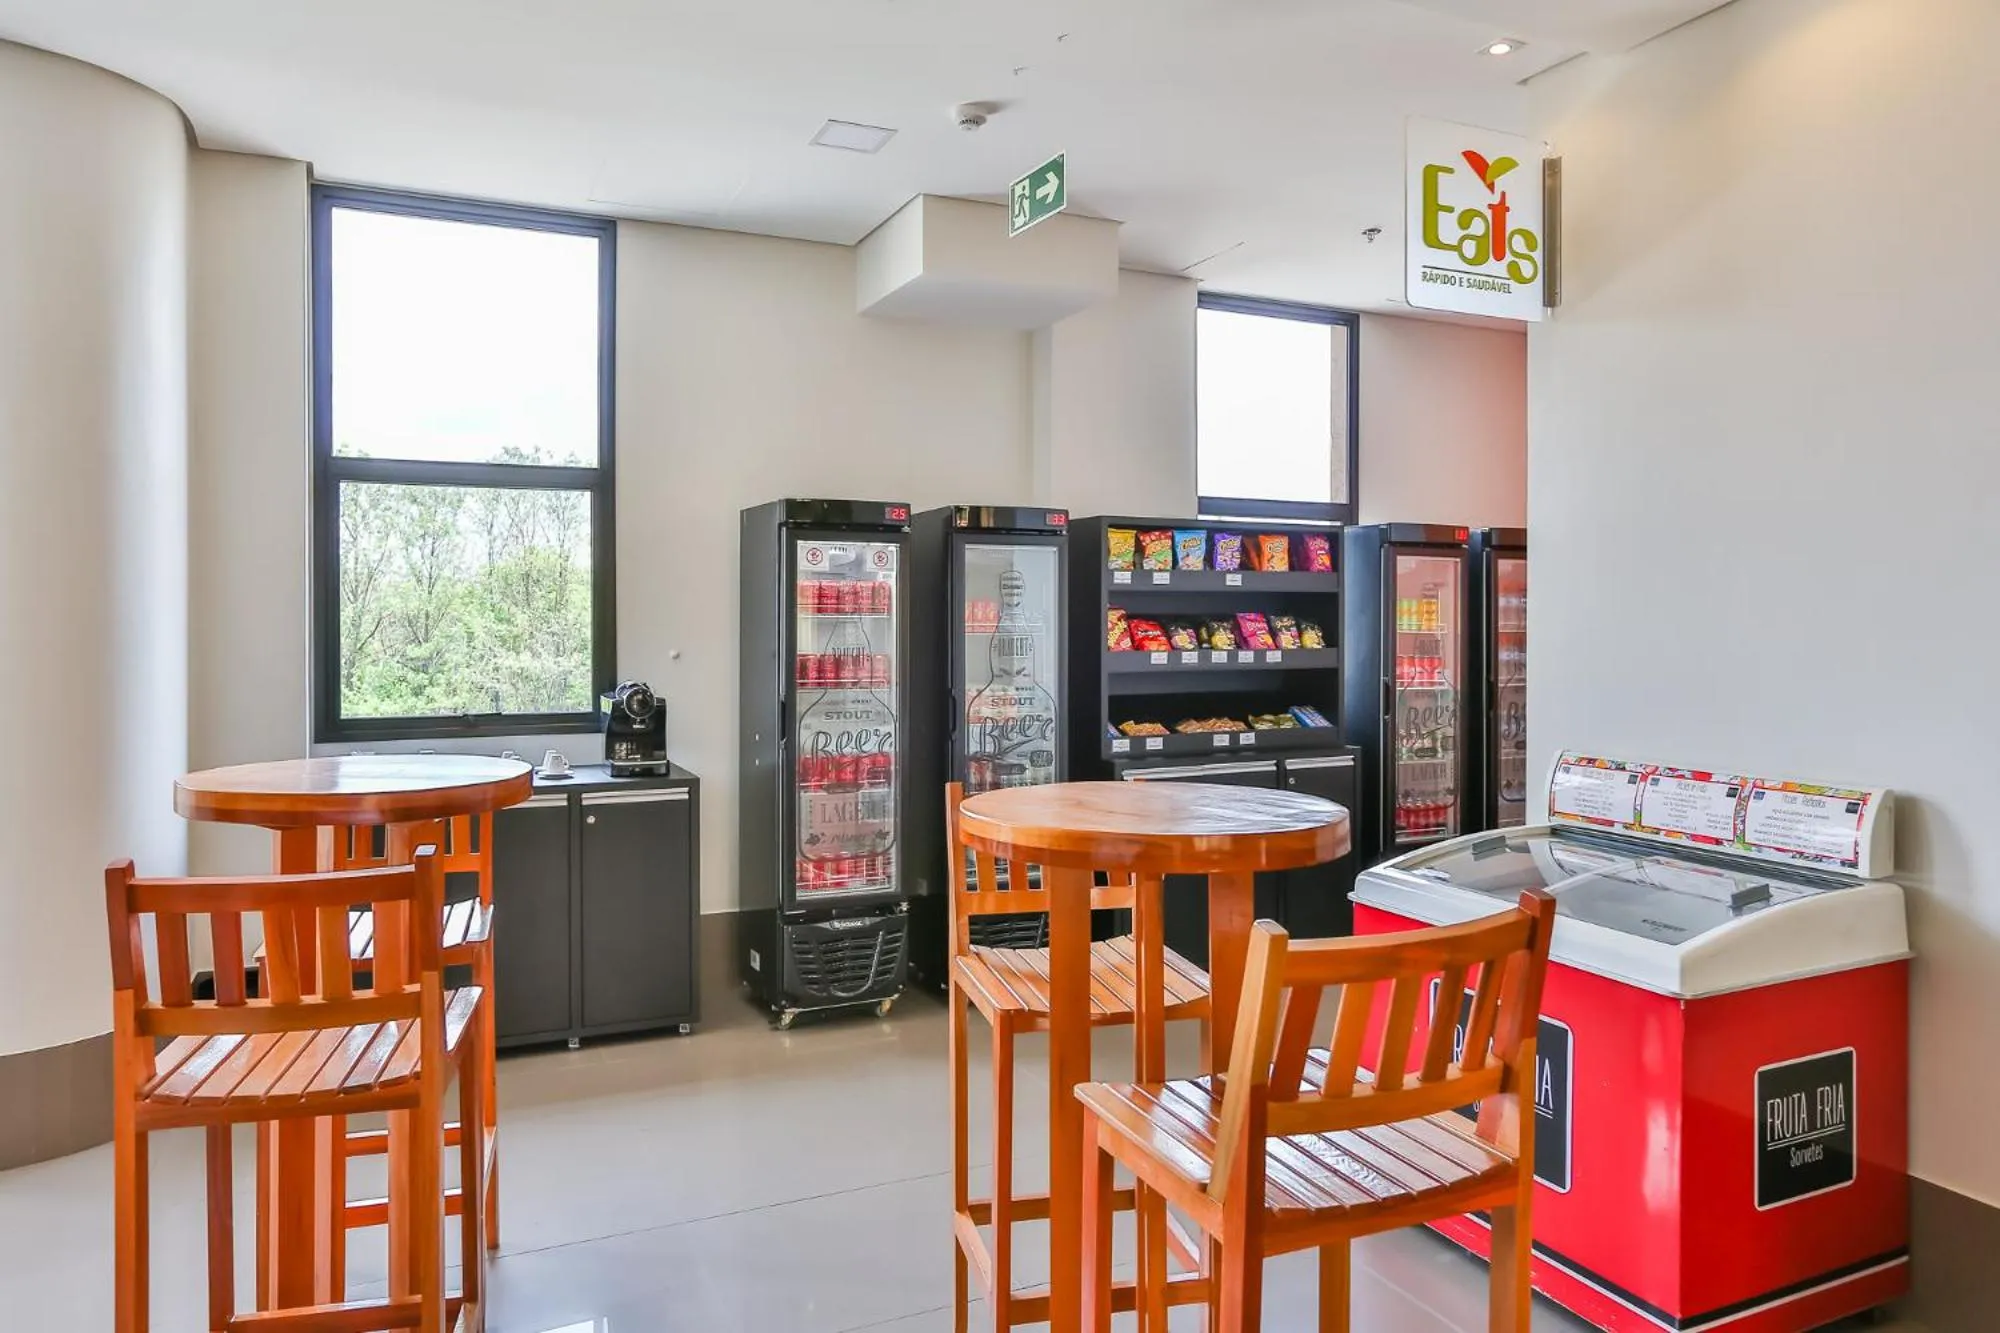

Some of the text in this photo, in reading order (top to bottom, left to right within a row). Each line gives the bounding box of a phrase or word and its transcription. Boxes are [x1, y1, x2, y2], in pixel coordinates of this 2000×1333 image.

[1423, 163, 1539, 285] Eats
[1421, 271, 1513, 294] RÁPIDO E SAUDÁVEL
[824, 710, 873, 721] STOUT
[1767, 1082, 1846, 1142] FRUTA FRIA
[1790, 1143, 1824, 1168] Sorvetes
